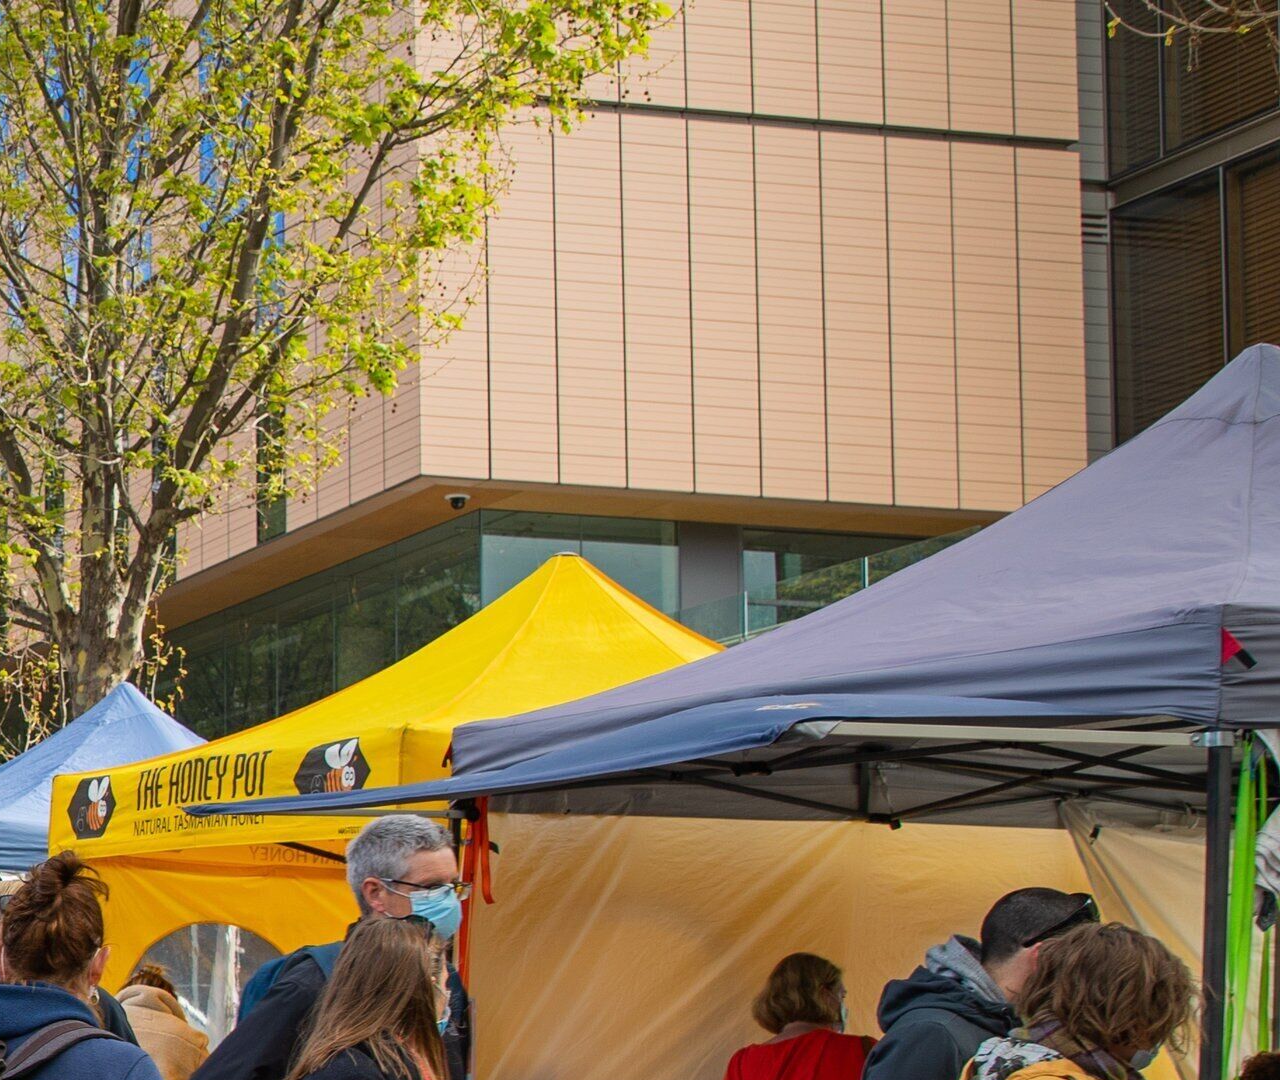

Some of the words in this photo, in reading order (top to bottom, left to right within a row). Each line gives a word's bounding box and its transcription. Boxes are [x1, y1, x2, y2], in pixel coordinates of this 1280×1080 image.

[137, 766, 168, 811] THE
[168, 755, 230, 806] HONEY
[232, 750, 272, 798] POT
[133, 816, 171, 836] NATURAL
[174, 814, 228, 832] TASMANIAN
[231, 814, 266, 827] HONEY
